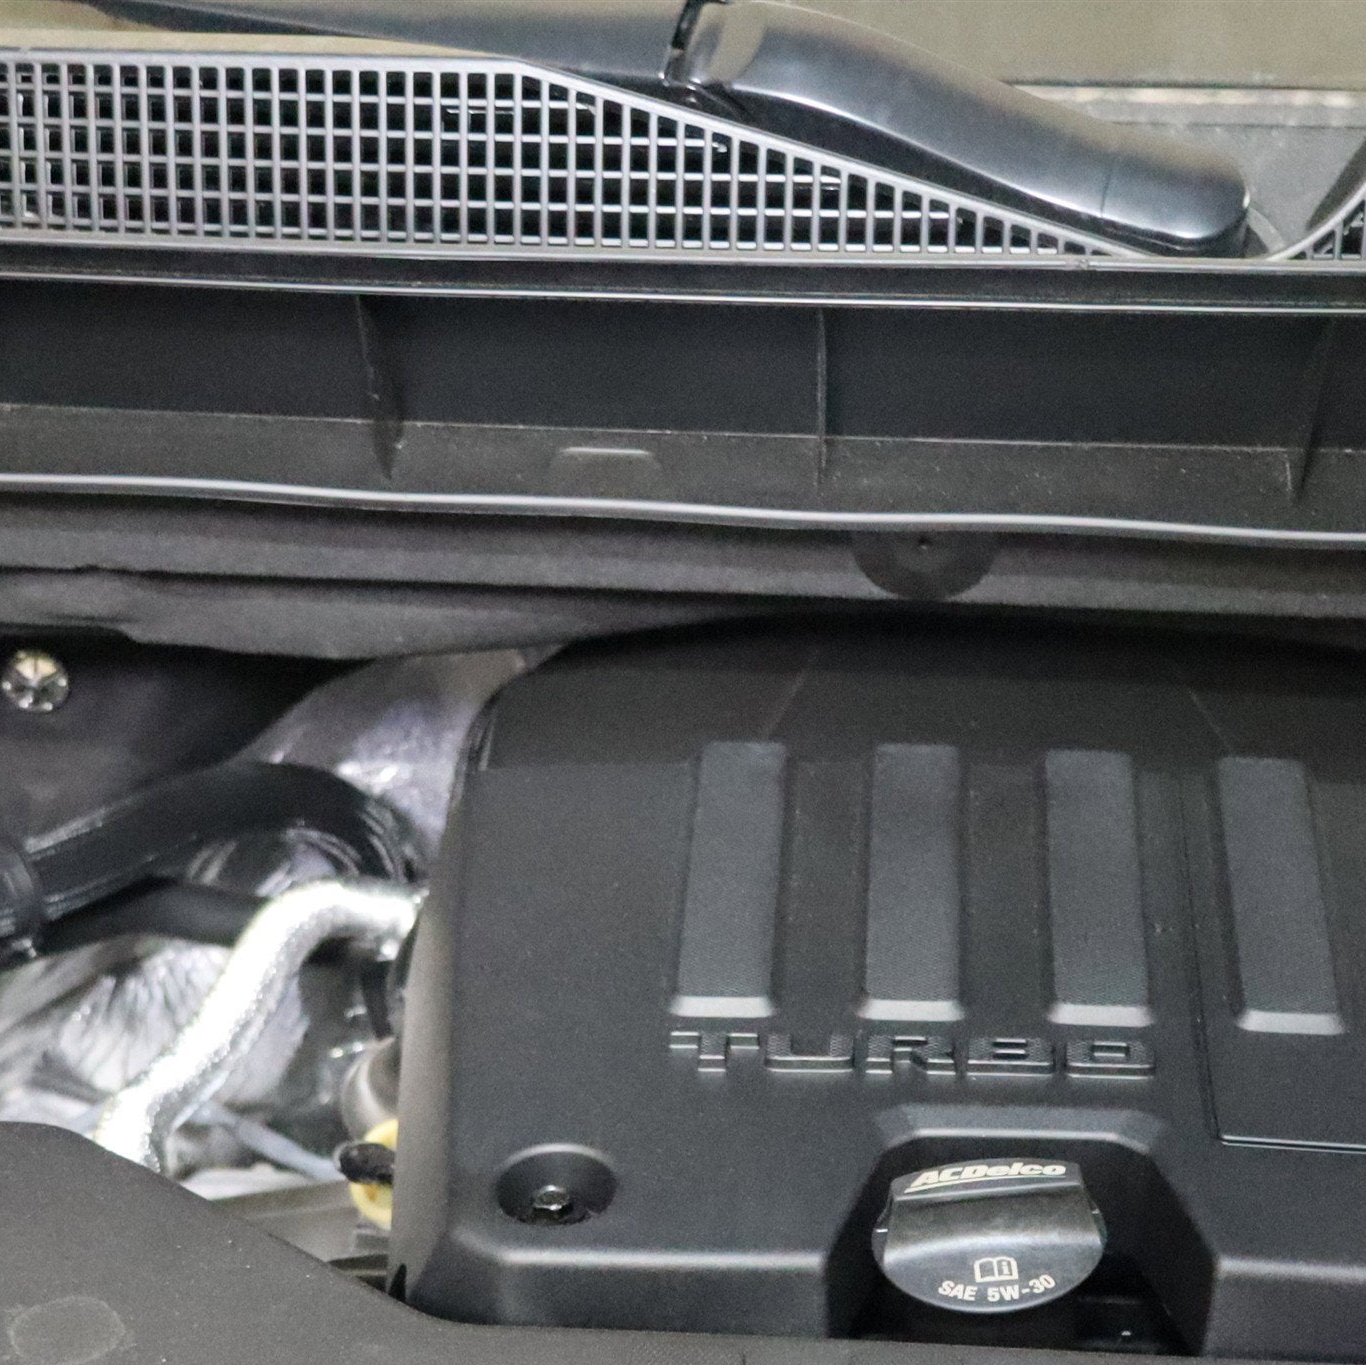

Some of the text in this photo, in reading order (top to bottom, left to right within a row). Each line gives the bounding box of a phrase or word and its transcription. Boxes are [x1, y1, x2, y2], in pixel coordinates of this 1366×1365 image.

[669, 1031, 1155, 1080] TURBO
[905, 1162, 1067, 1192] ACDelco
[938, 1274, 1056, 1302] SAE 5W-30
